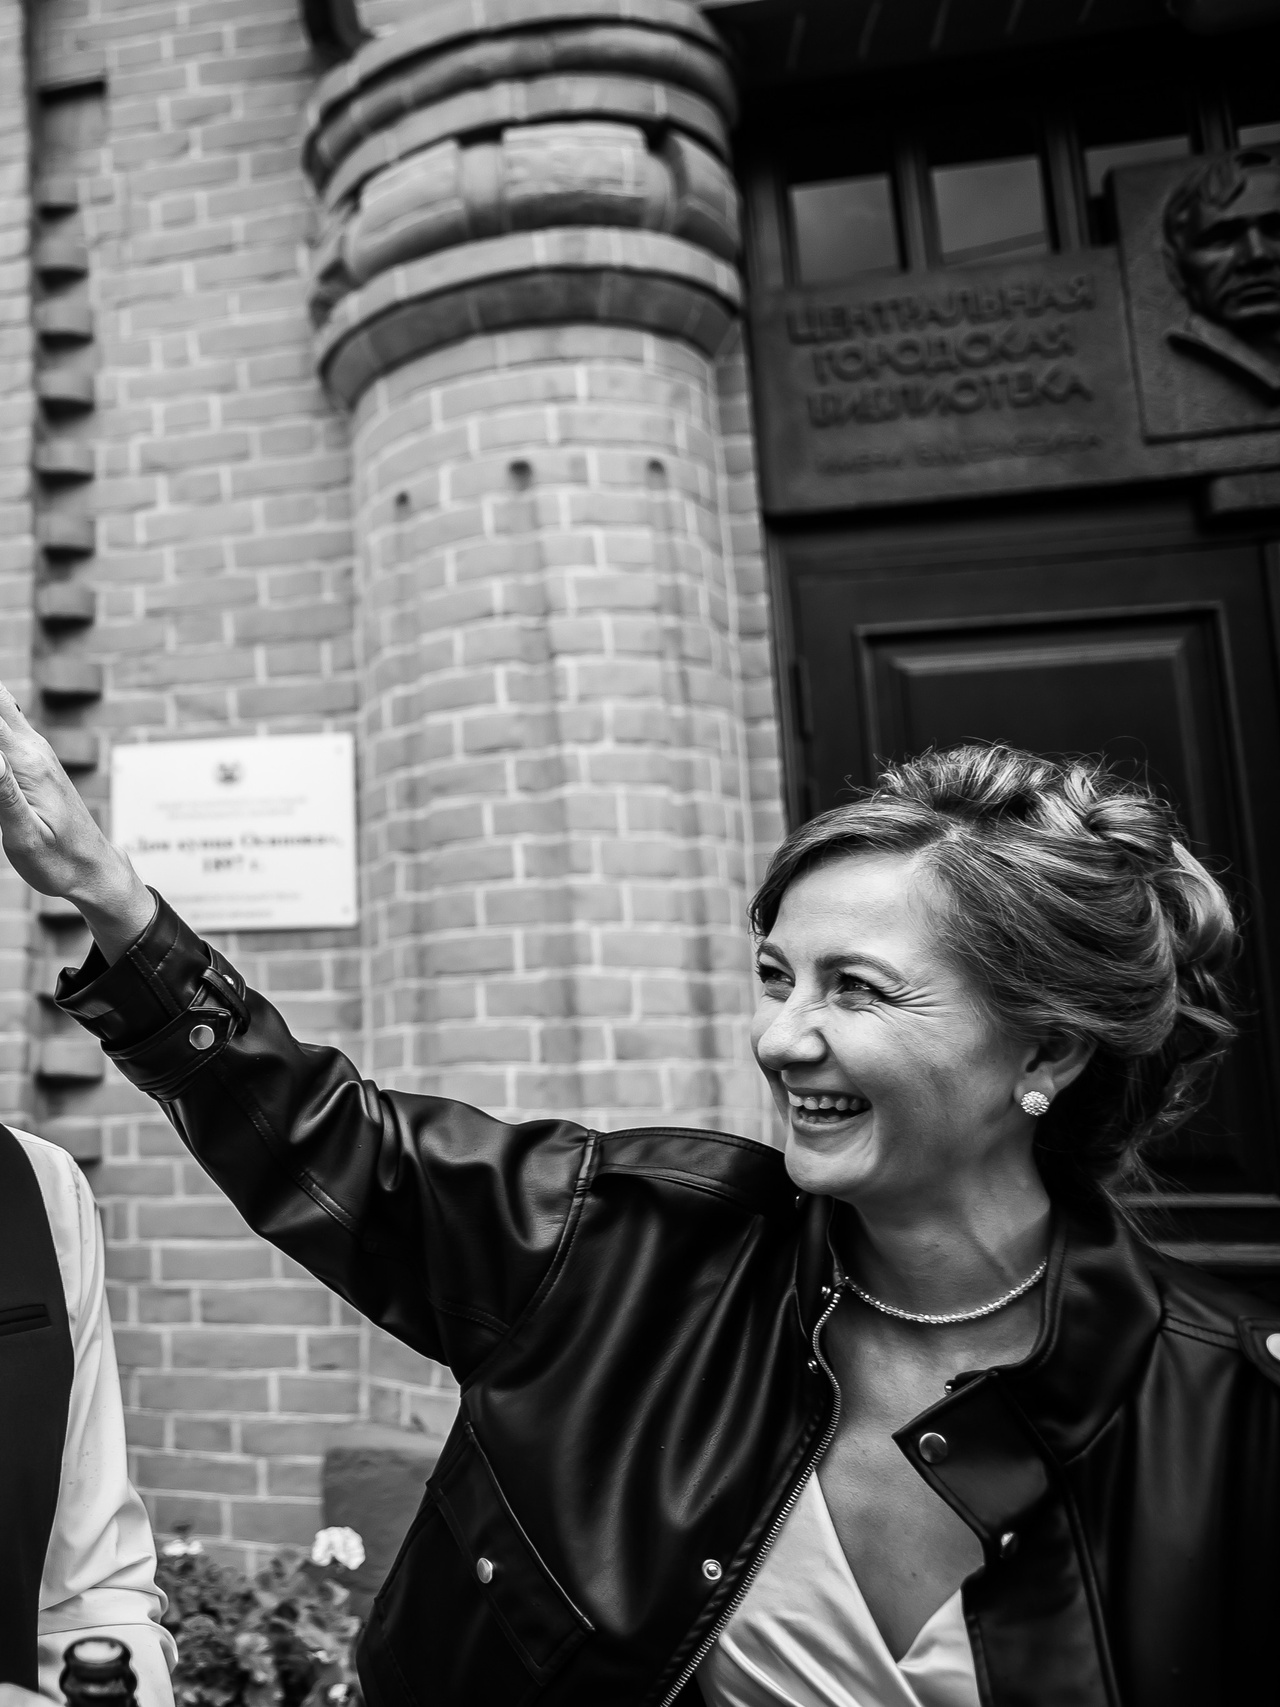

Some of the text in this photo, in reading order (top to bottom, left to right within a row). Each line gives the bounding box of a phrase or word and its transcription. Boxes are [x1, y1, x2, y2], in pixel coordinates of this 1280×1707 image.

[786, 273, 1095, 345] ЦЕНТРАЛЬНАЯ
[811, 321, 1076, 386] ГОРОДСКАЯ
[806, 364, 1094, 428] БИБЛИОТЕКА
